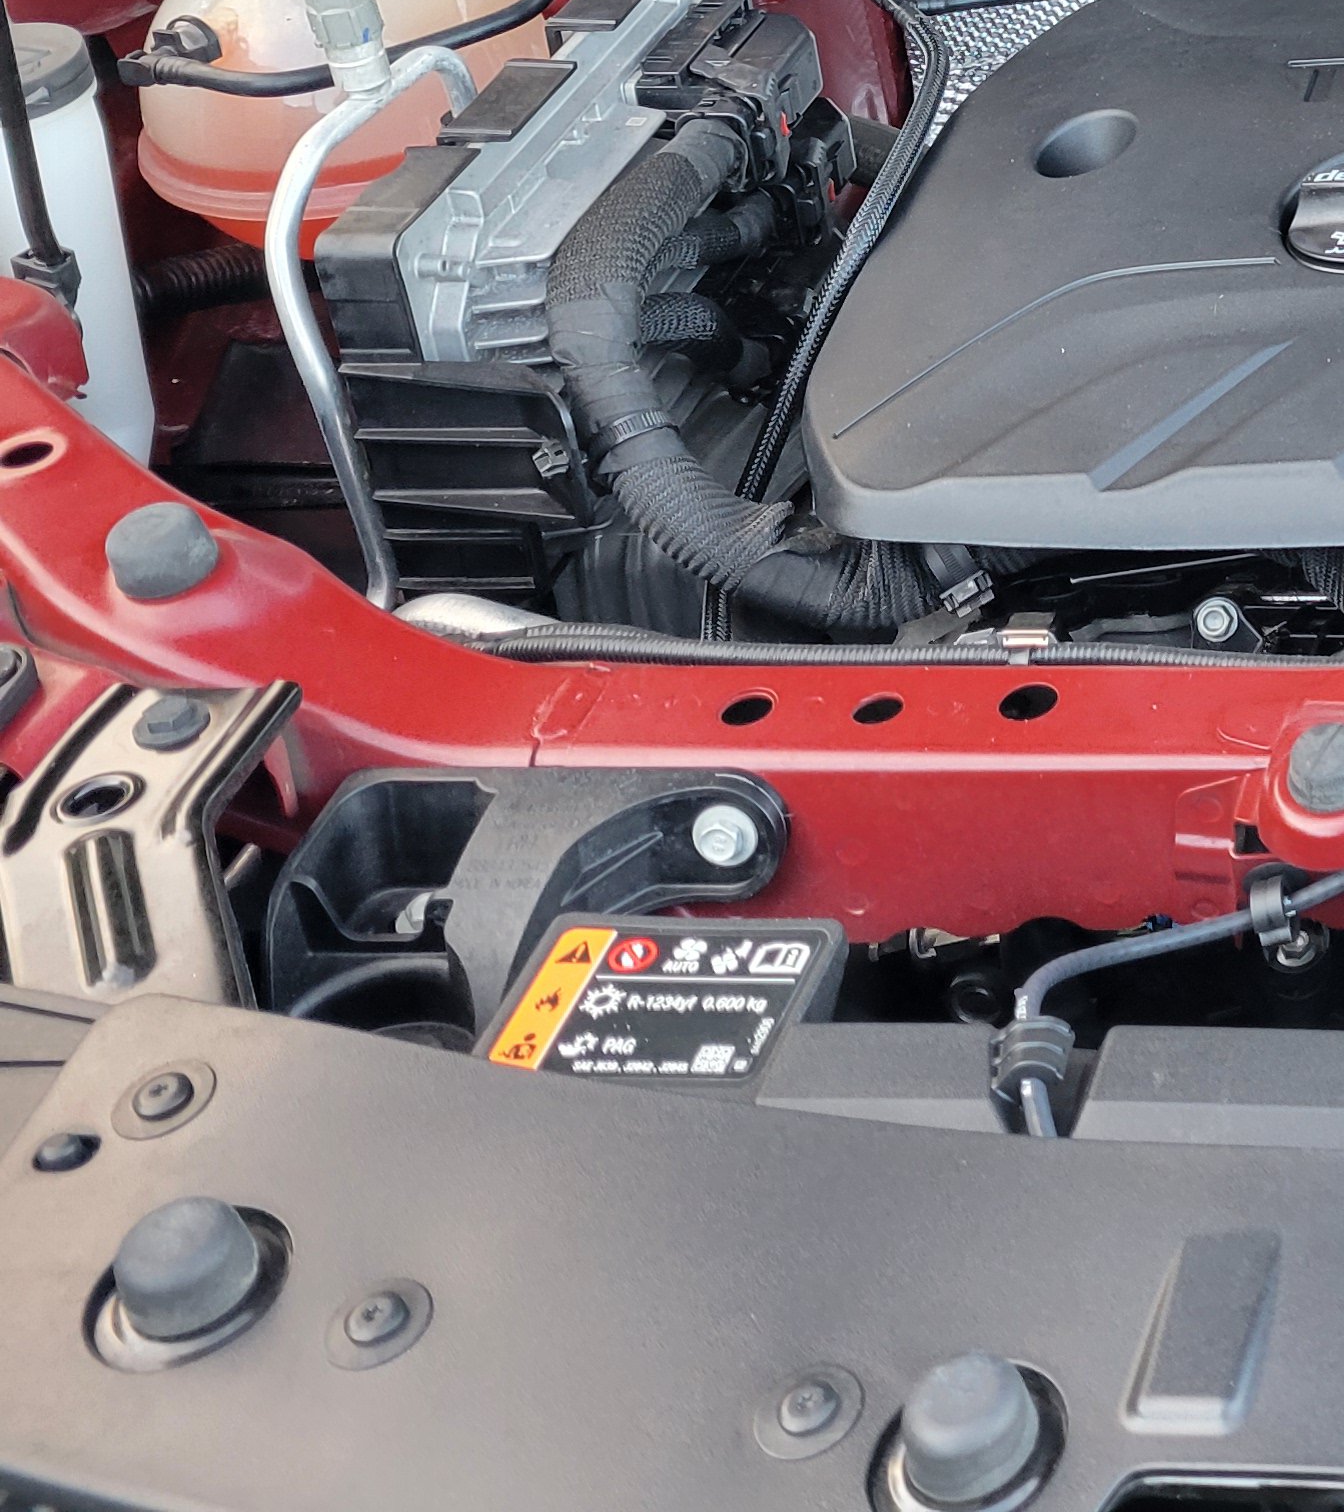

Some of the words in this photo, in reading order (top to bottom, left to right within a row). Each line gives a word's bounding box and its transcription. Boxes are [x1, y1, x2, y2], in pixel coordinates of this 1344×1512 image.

[662, 960, 699, 974] AUTO
[626, 995, 698, 1014] R-1234yf
[701, 996, 746, 1013] 0.600
[601, 1038, 638, 1056] PAG
